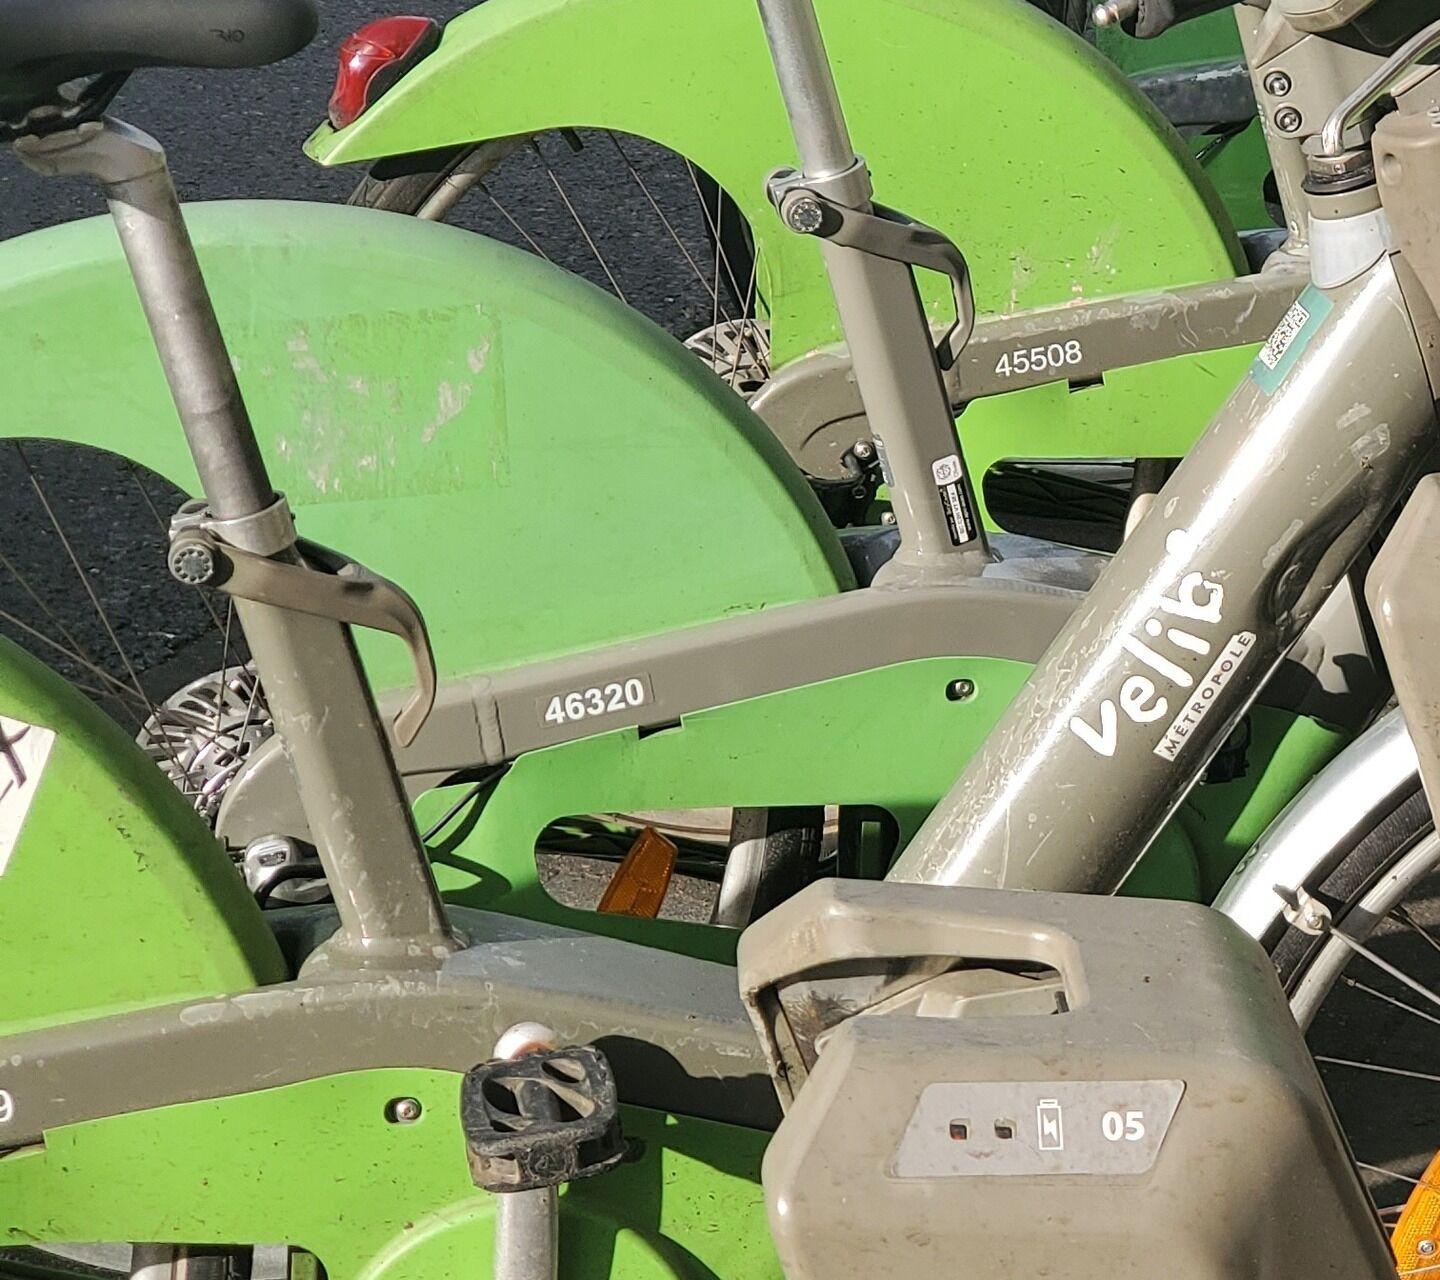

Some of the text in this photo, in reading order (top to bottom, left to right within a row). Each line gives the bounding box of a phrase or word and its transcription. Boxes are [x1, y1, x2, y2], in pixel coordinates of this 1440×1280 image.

[995, 340, 1082, 376] 45508
[545, 679, 644, 724] 46320
[1163, 634, 1252, 758] MÉTROPOLE
[1102, 1111, 1145, 1142] 05
